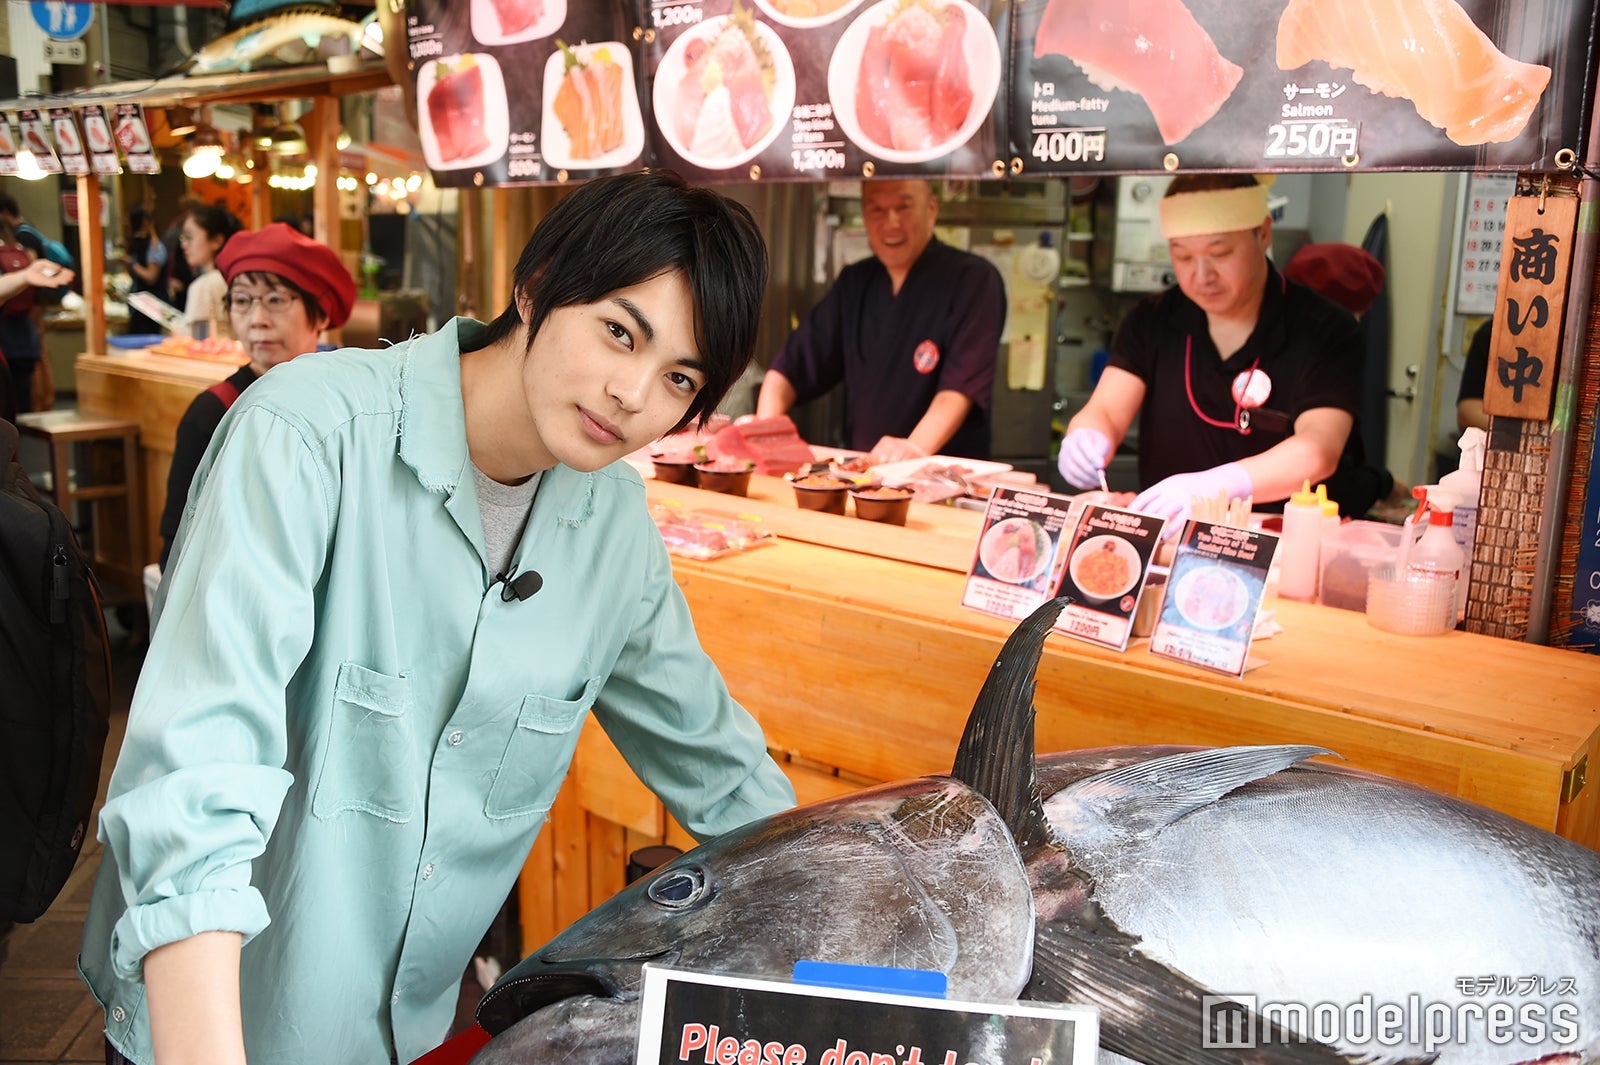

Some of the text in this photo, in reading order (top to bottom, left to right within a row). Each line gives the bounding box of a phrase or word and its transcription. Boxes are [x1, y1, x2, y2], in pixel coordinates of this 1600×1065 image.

[1033, 81, 1055, 98] トロ
[1283, 82, 1347, 101] サーモン
[1031, 97, 1110, 112] Medium-fatty
[1281, 102, 1334, 118] Salmon
[1032, 132, 1105, 162] 400円
[1266, 123, 1358, 157] 250円
[1469, 220, 1480, 231] 12
[1484, 221, 1494, 232] 13
[1480, 241, 1492, 252] 20
[1497, 227, 1560, 404] 商い中
[679, 1022, 807, 1065] Please
